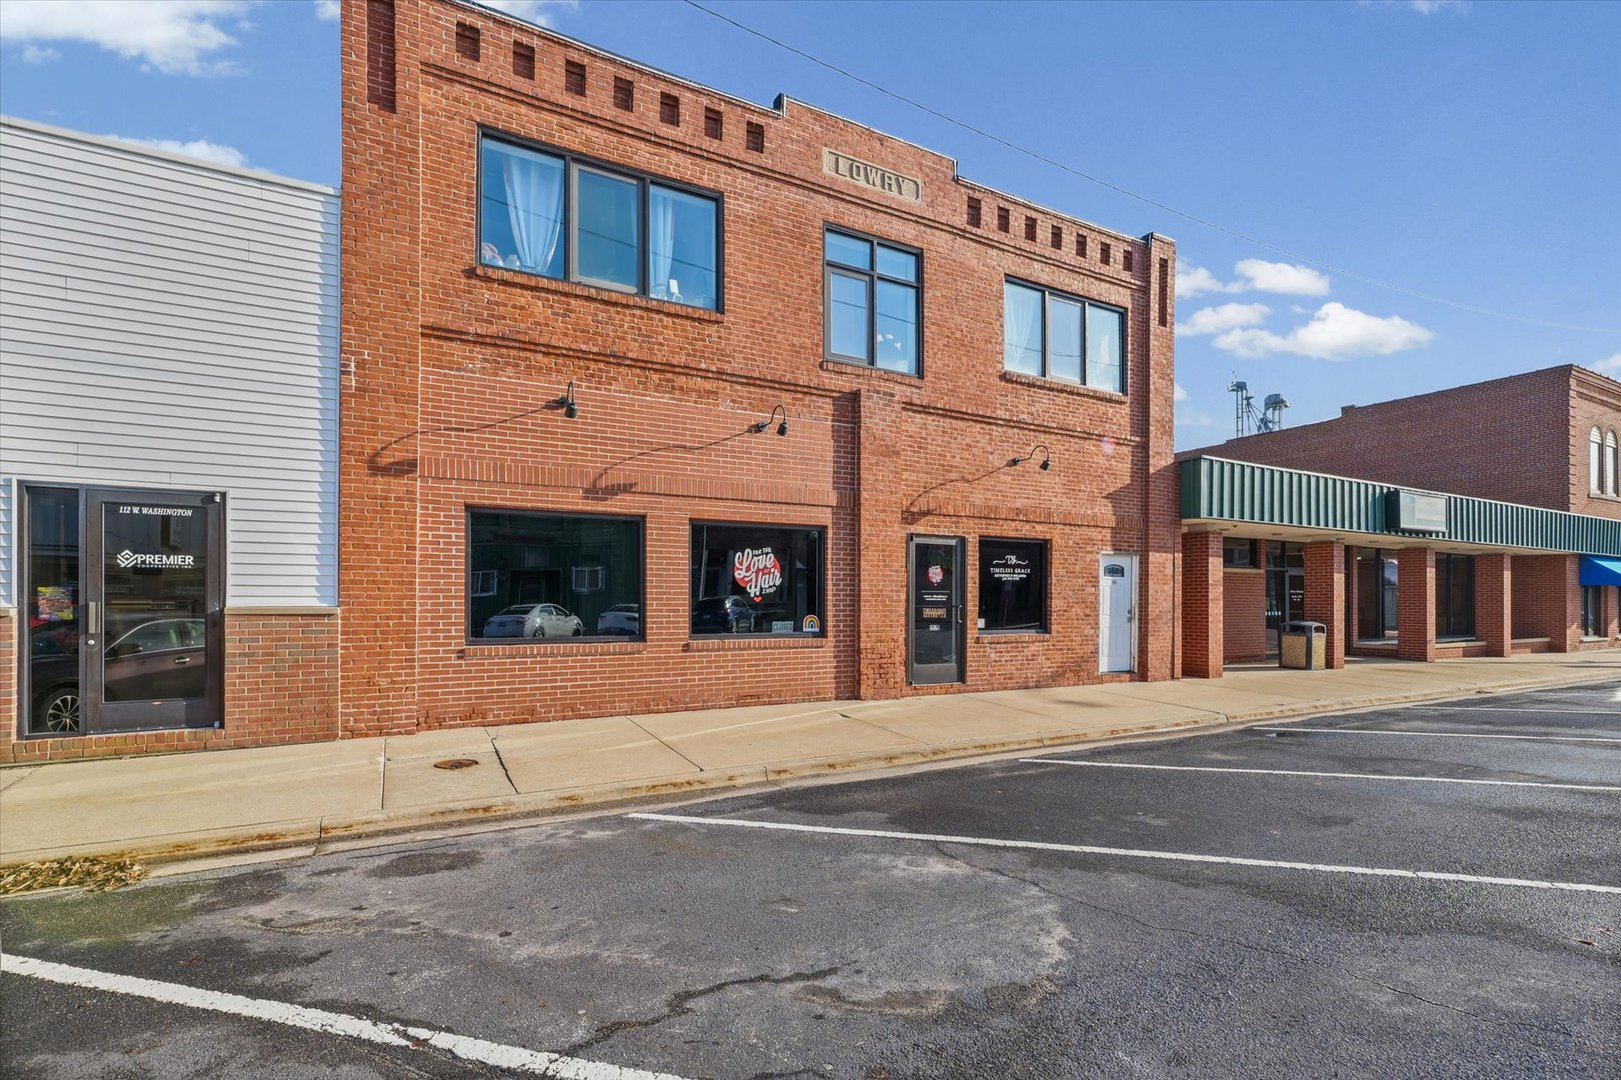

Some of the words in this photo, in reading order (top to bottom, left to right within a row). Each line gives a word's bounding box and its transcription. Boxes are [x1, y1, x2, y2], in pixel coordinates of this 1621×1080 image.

[834, 156, 906, 196] LOWRY
[119, 506, 131, 514] 112
[141, 507, 193, 516] WASHINGTON
[137, 554, 194, 565] PREMIER
[734, 548, 775, 581] Love
[746, 569, 782, 597] Hair
[761, 586, 776, 594] SHOP
